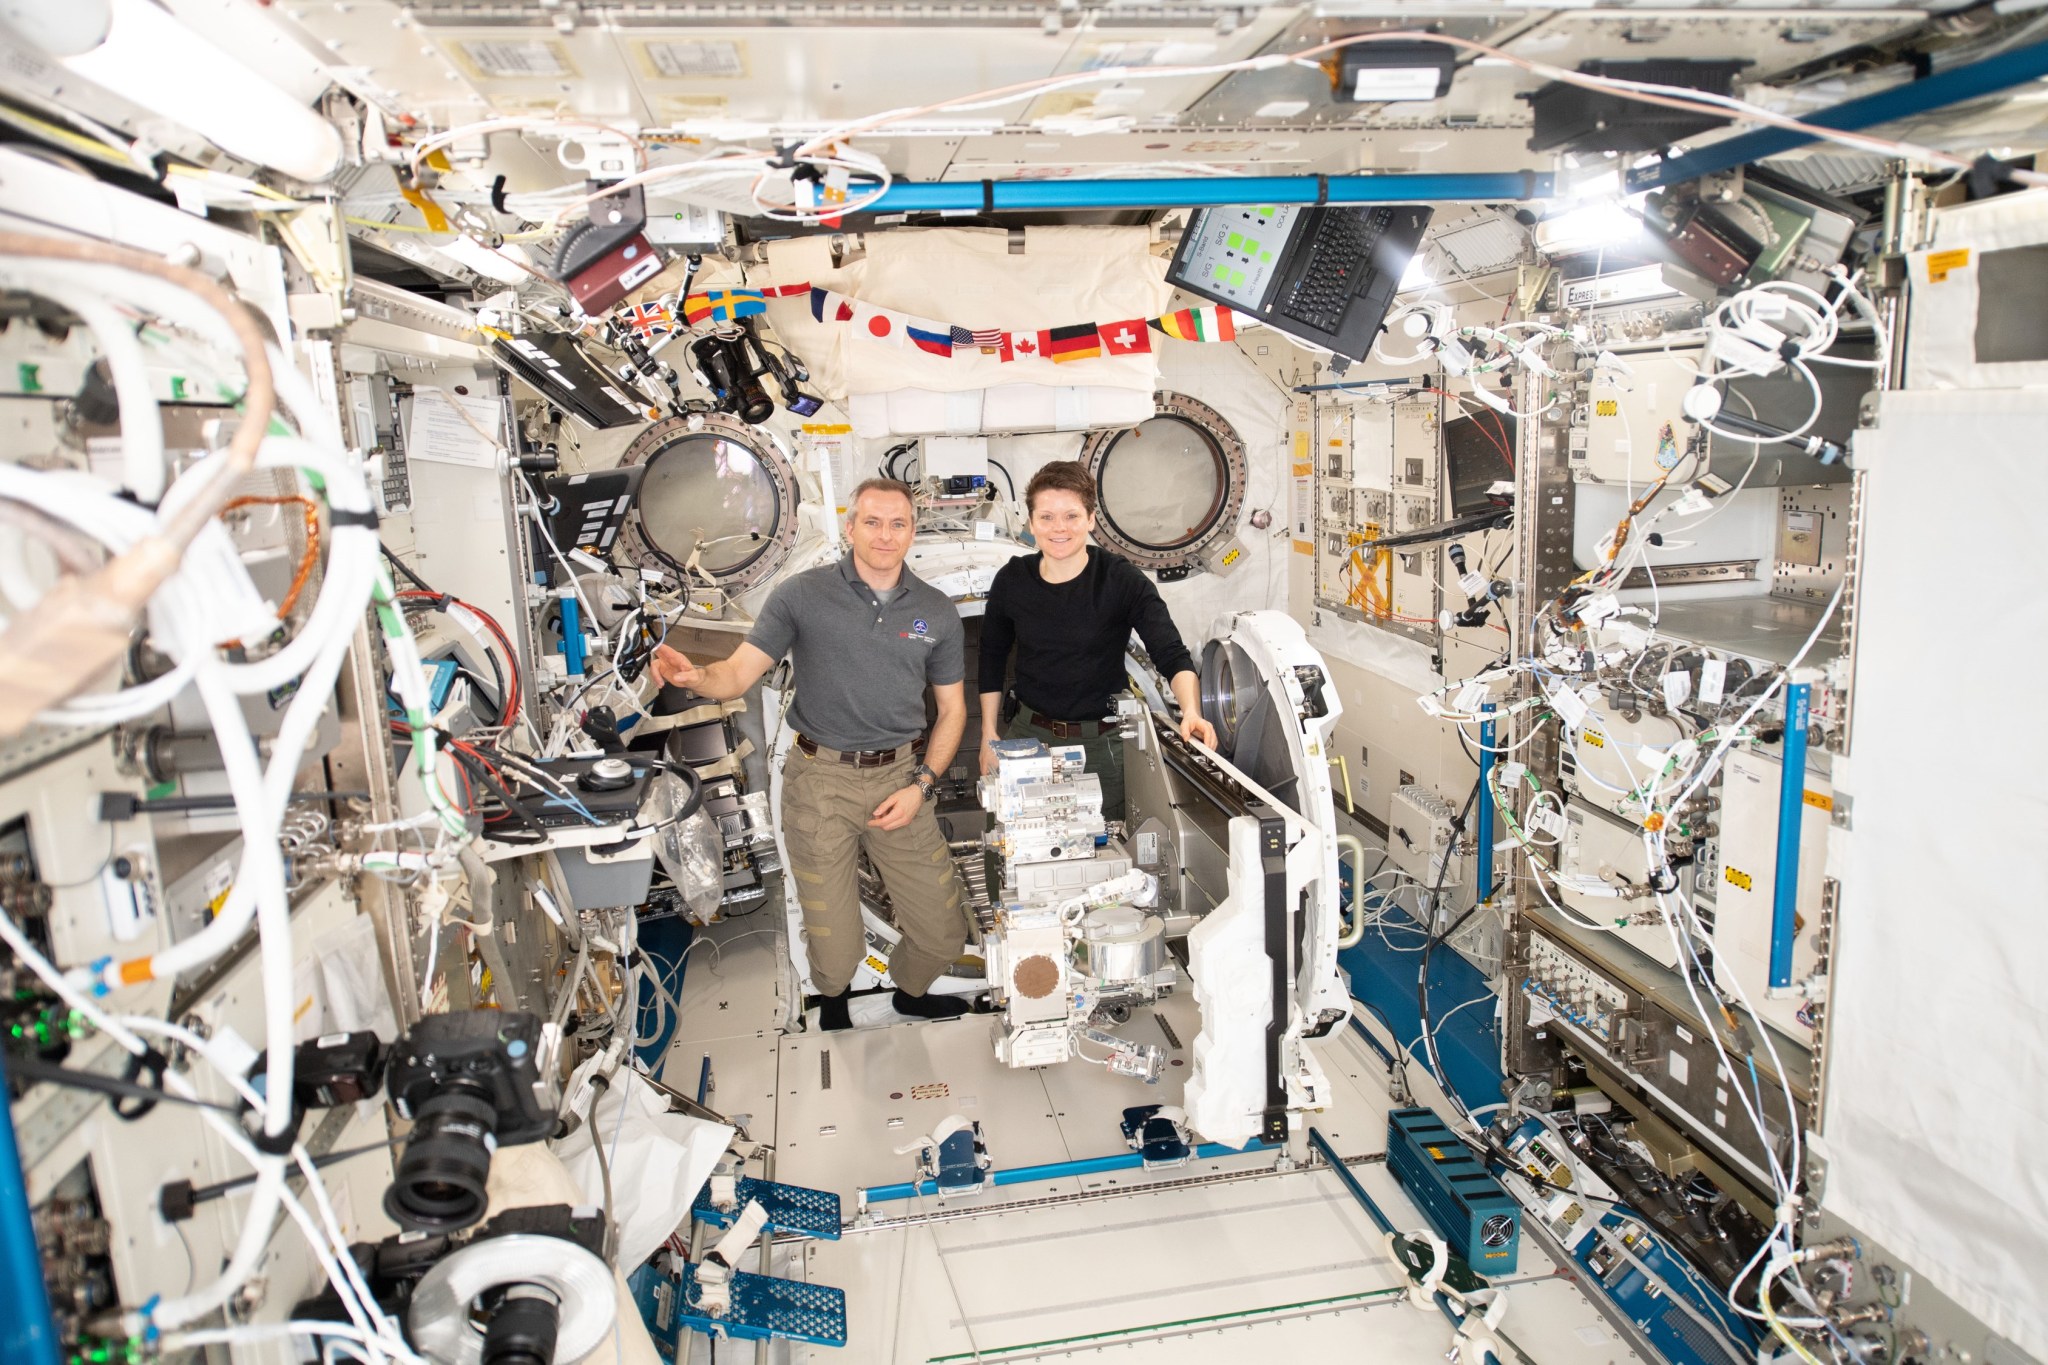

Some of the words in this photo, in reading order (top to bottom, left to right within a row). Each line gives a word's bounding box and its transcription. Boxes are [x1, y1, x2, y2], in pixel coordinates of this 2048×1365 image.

[1276, 215, 1286, 228] OCA
[1215, 231, 1226, 246] S/G
[1196, 236, 1208, 257] S-Band
[1202, 263, 1213, 278] S/G
[1567, 286, 1597, 302] EXPRES
